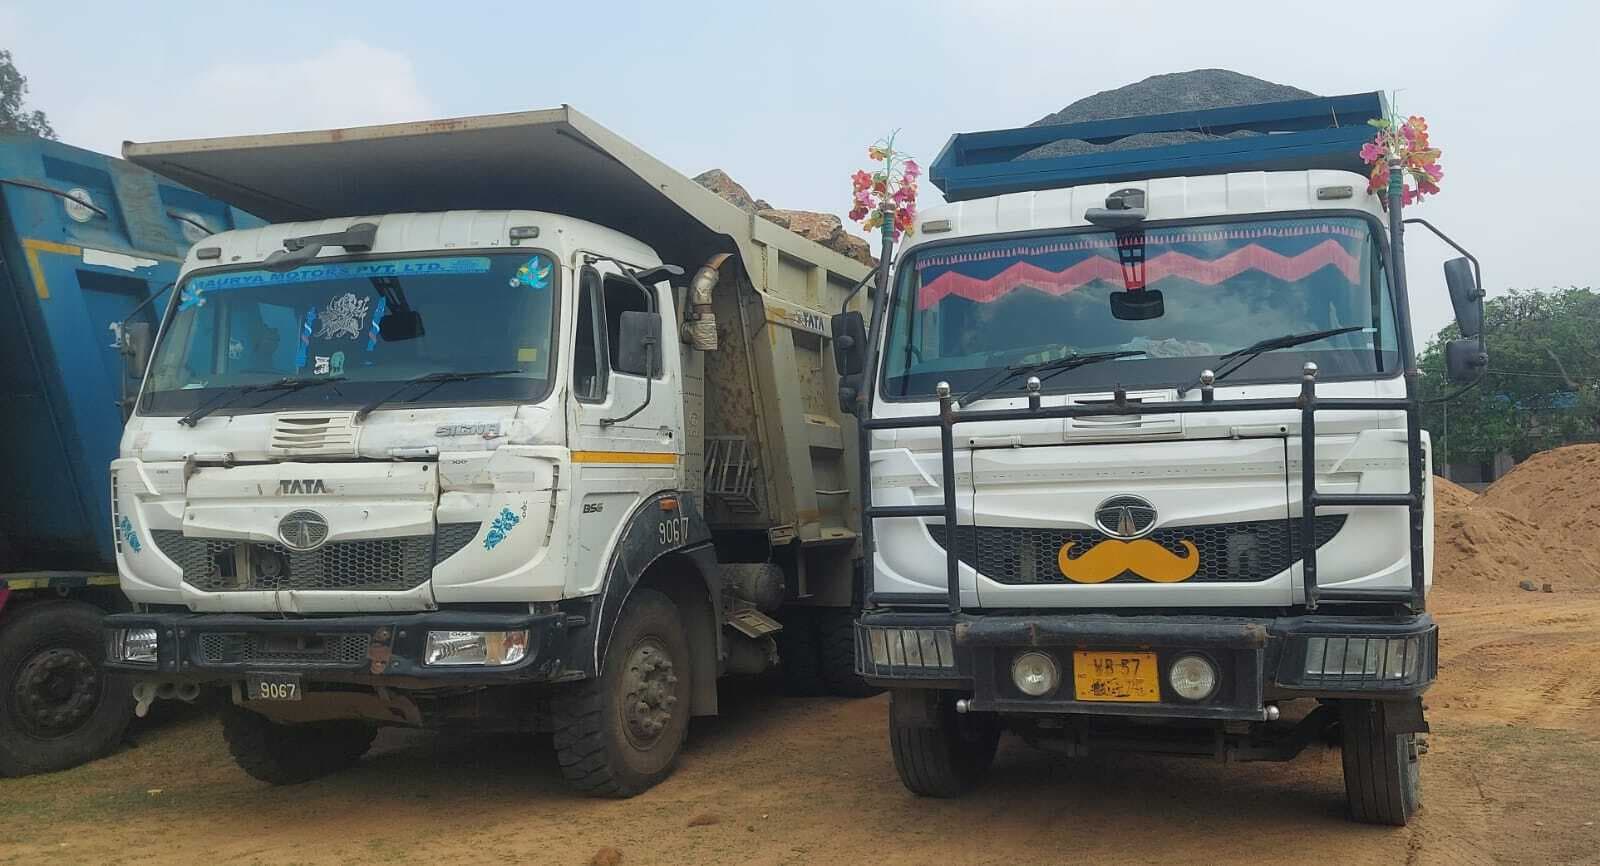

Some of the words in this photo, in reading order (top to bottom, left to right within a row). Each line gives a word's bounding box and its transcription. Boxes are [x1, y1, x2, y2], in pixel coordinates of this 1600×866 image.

[357, 264, 396, 273] PVT.
[279, 479, 327, 494] TATA
[583, 503, 604, 514] BS6
[659, 516, 689, 544] 9067
[260, 682, 296, 698] 9067
